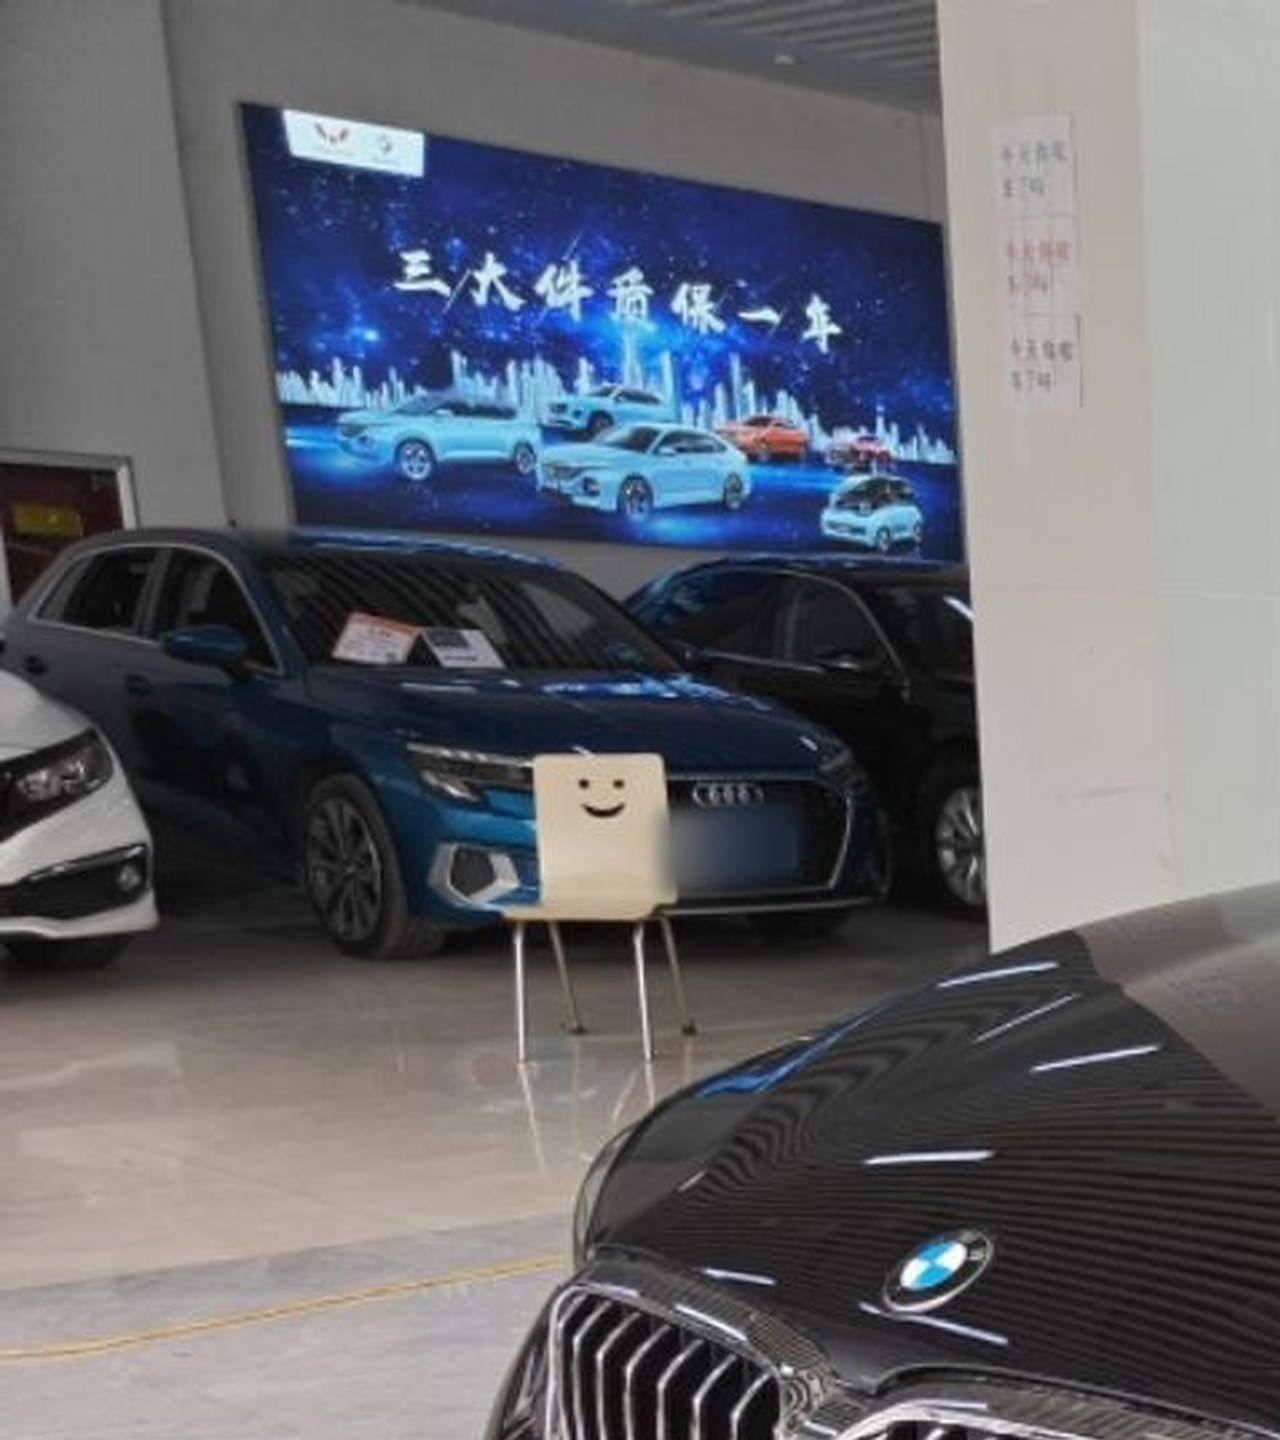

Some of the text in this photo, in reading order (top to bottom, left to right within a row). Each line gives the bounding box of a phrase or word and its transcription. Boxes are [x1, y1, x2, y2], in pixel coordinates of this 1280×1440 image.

[393, 249, 842, 353] 三大件质保一年
